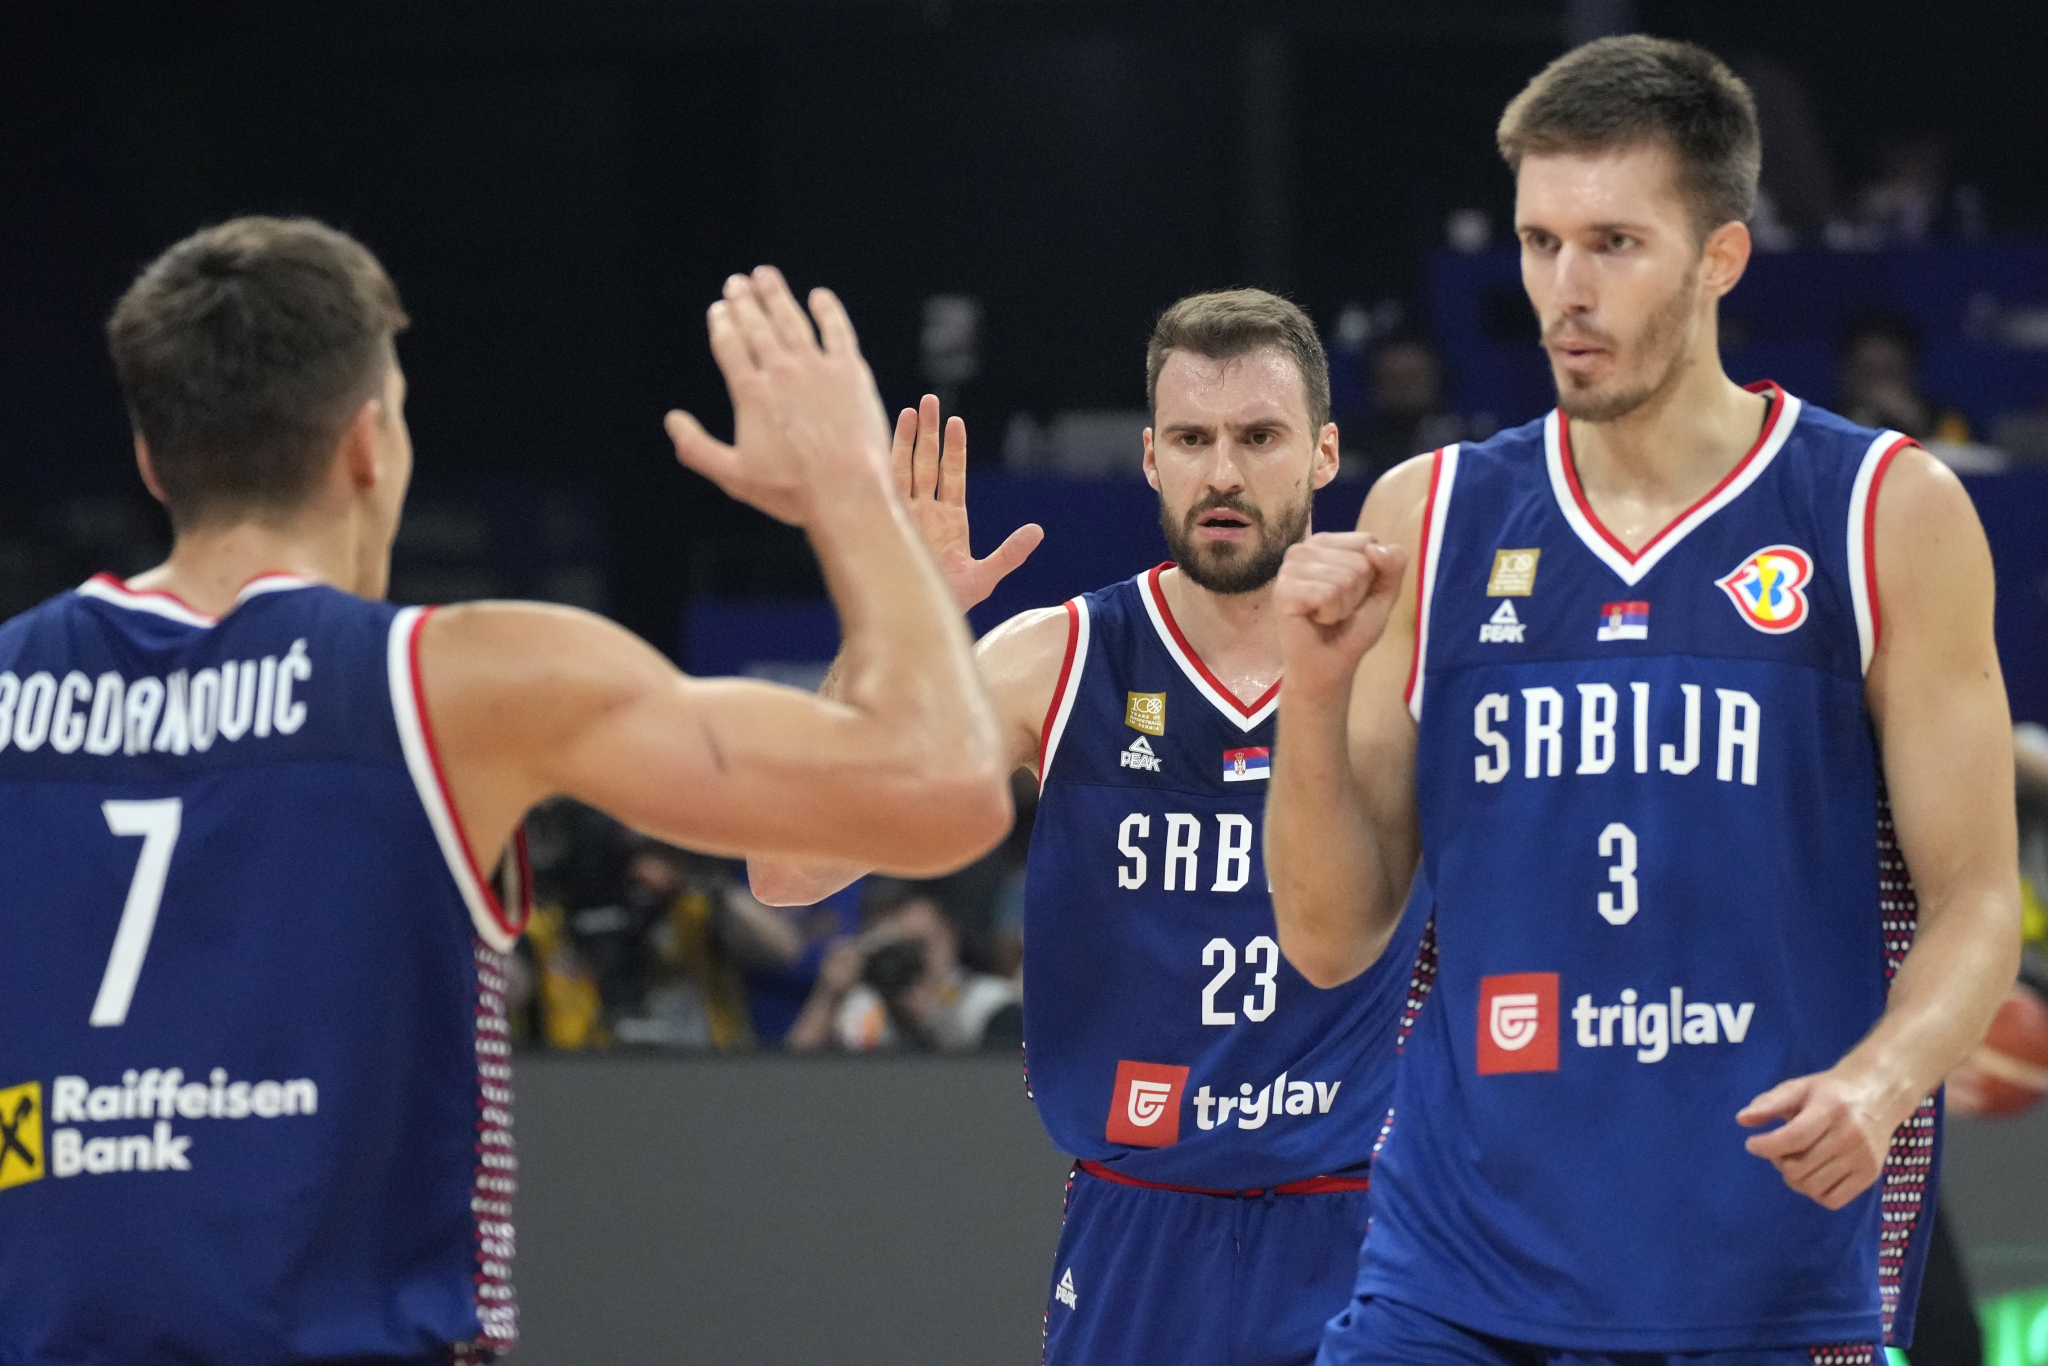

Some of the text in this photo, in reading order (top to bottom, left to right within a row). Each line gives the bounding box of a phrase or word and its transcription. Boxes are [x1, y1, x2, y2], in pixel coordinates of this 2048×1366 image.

[1479, 624, 1527, 643] PEAK
[1130, 710, 1150, 720] YEARS
[1130, 715, 1162, 726] BASKETBALL
[1138, 722, 1160, 731] SERBIA
[1474, 682, 1761, 786] SRBIJA
[1120, 750, 1163, 773] PEAK
[1118, 812, 1273, 892] SRB
[1598, 823, 1639, 925] 3
[90, 798, 182, 1027] 7
[1201, 936, 1278, 1026] 23
[1571, 986, 1756, 1064] triglav
[52, 1067, 318, 1123] Raiffeisen
[52, 1119, 193, 1178] Bank
[1055, 1283, 1078, 1310] PEAK
